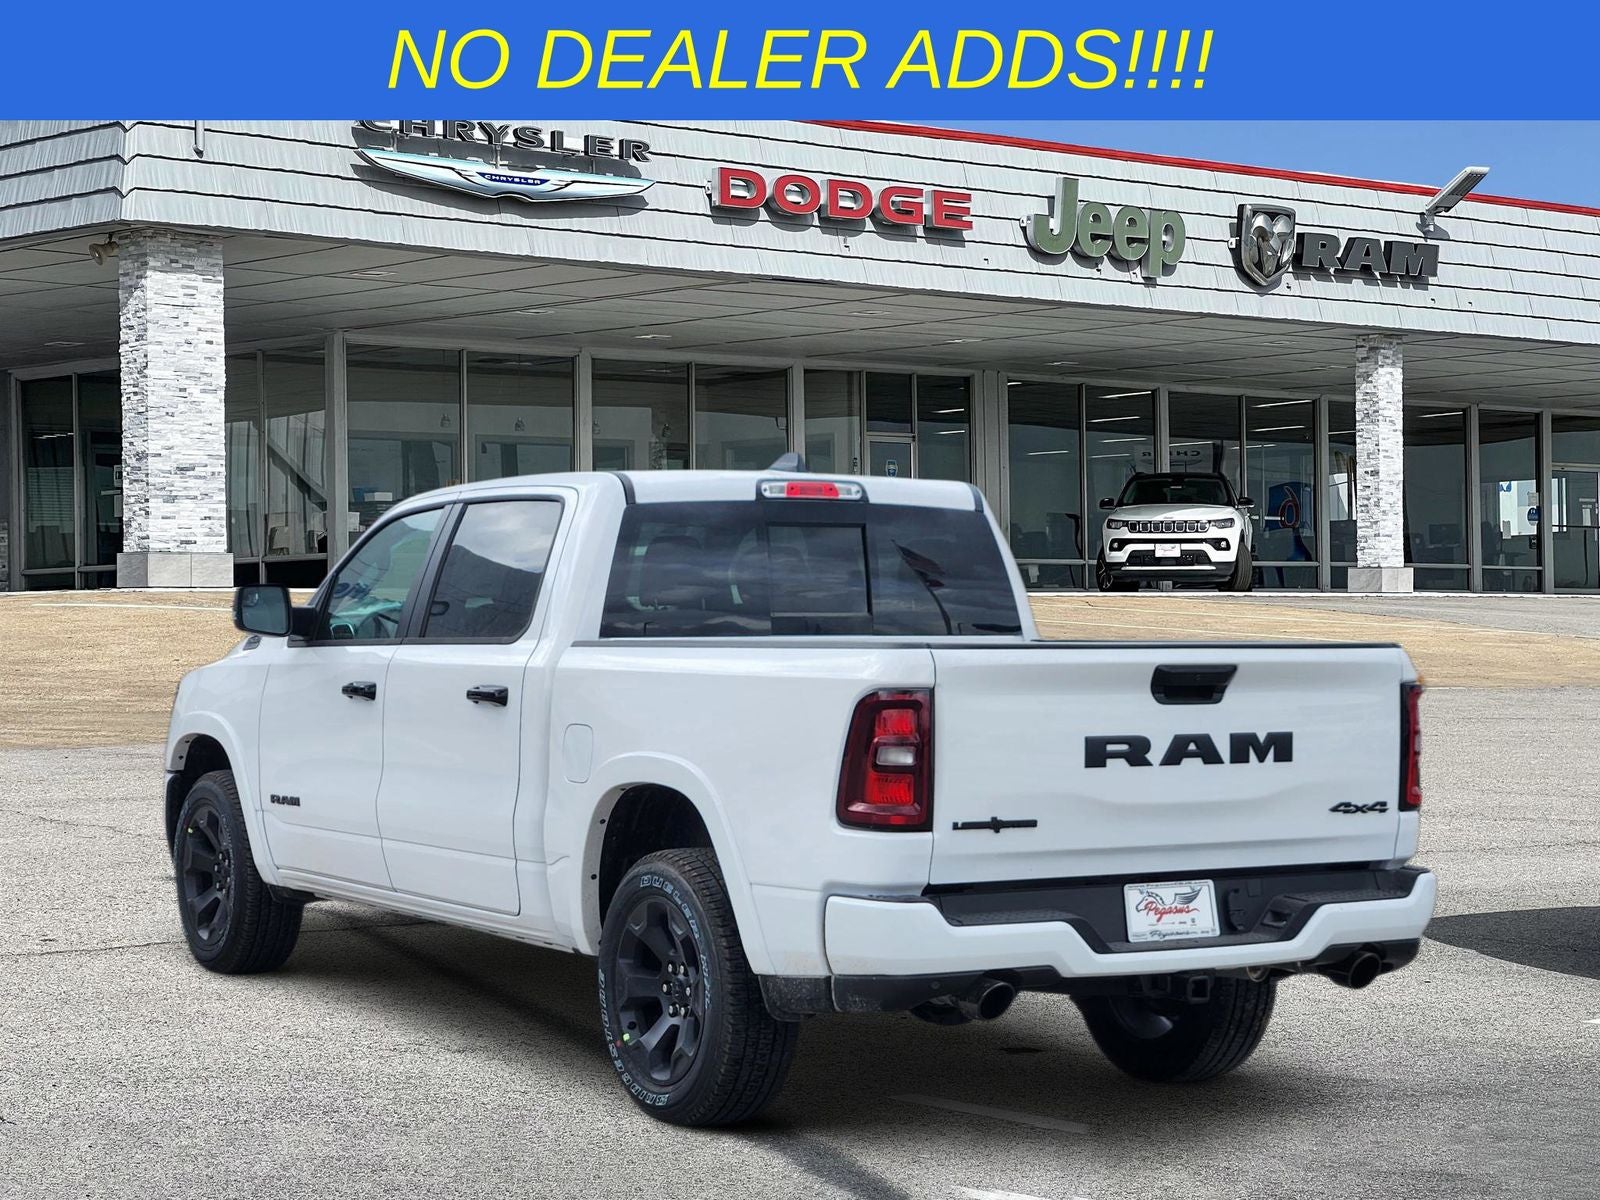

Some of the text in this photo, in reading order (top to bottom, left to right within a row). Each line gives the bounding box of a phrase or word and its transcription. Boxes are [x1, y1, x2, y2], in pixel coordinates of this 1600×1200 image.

[484, 174, 541, 186] CHRYSLER
[712, 166, 974, 231] DODGE
[1027, 177, 1186, 279] Jeep
[1298, 232, 1440, 277] RAM
[1084, 731, 1294, 768] RAM
[270, 794, 301, 807] RAM
[1328, 801, 1389, 814] 4x4
[1144, 900, 1201, 923] Pegasus
